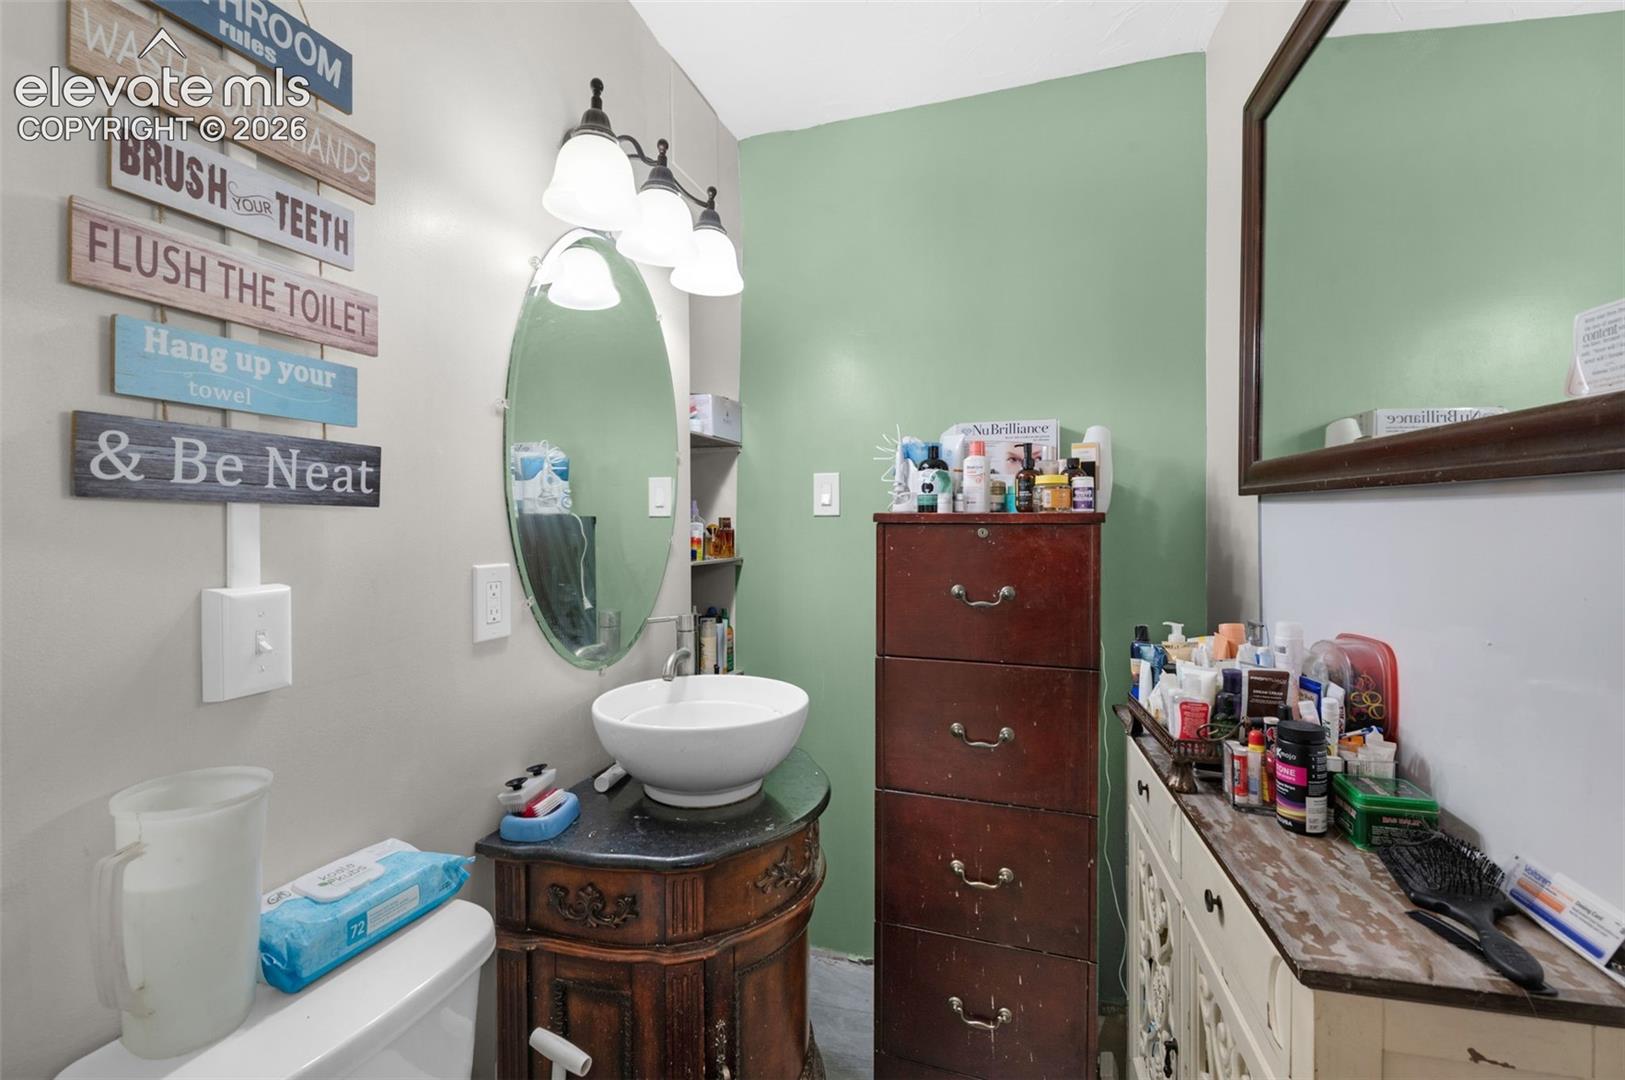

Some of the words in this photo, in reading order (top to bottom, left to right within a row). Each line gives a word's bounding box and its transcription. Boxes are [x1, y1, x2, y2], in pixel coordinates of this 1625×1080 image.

[205, 0, 342, 89] HROOM
[219, 19, 277, 64] rules
[119, 130, 227, 210] BRUSH
[232, 196, 272, 215] YOUR
[275, 191, 349, 255] TEETH
[89, 221, 206, 292] FLUSH
[218, 261, 276, 312] THE
[284, 281, 370, 337] TOILET
[143, 325, 229, 373] Hang
[236, 349, 271, 380] up
[277, 359, 337, 389] your
[187, 379, 252, 405] towel
[90, 430, 145, 482] &
[170, 436, 244, 487] Be
[264, 446, 374, 494] Neat
[350, 920, 365, 939] 72
